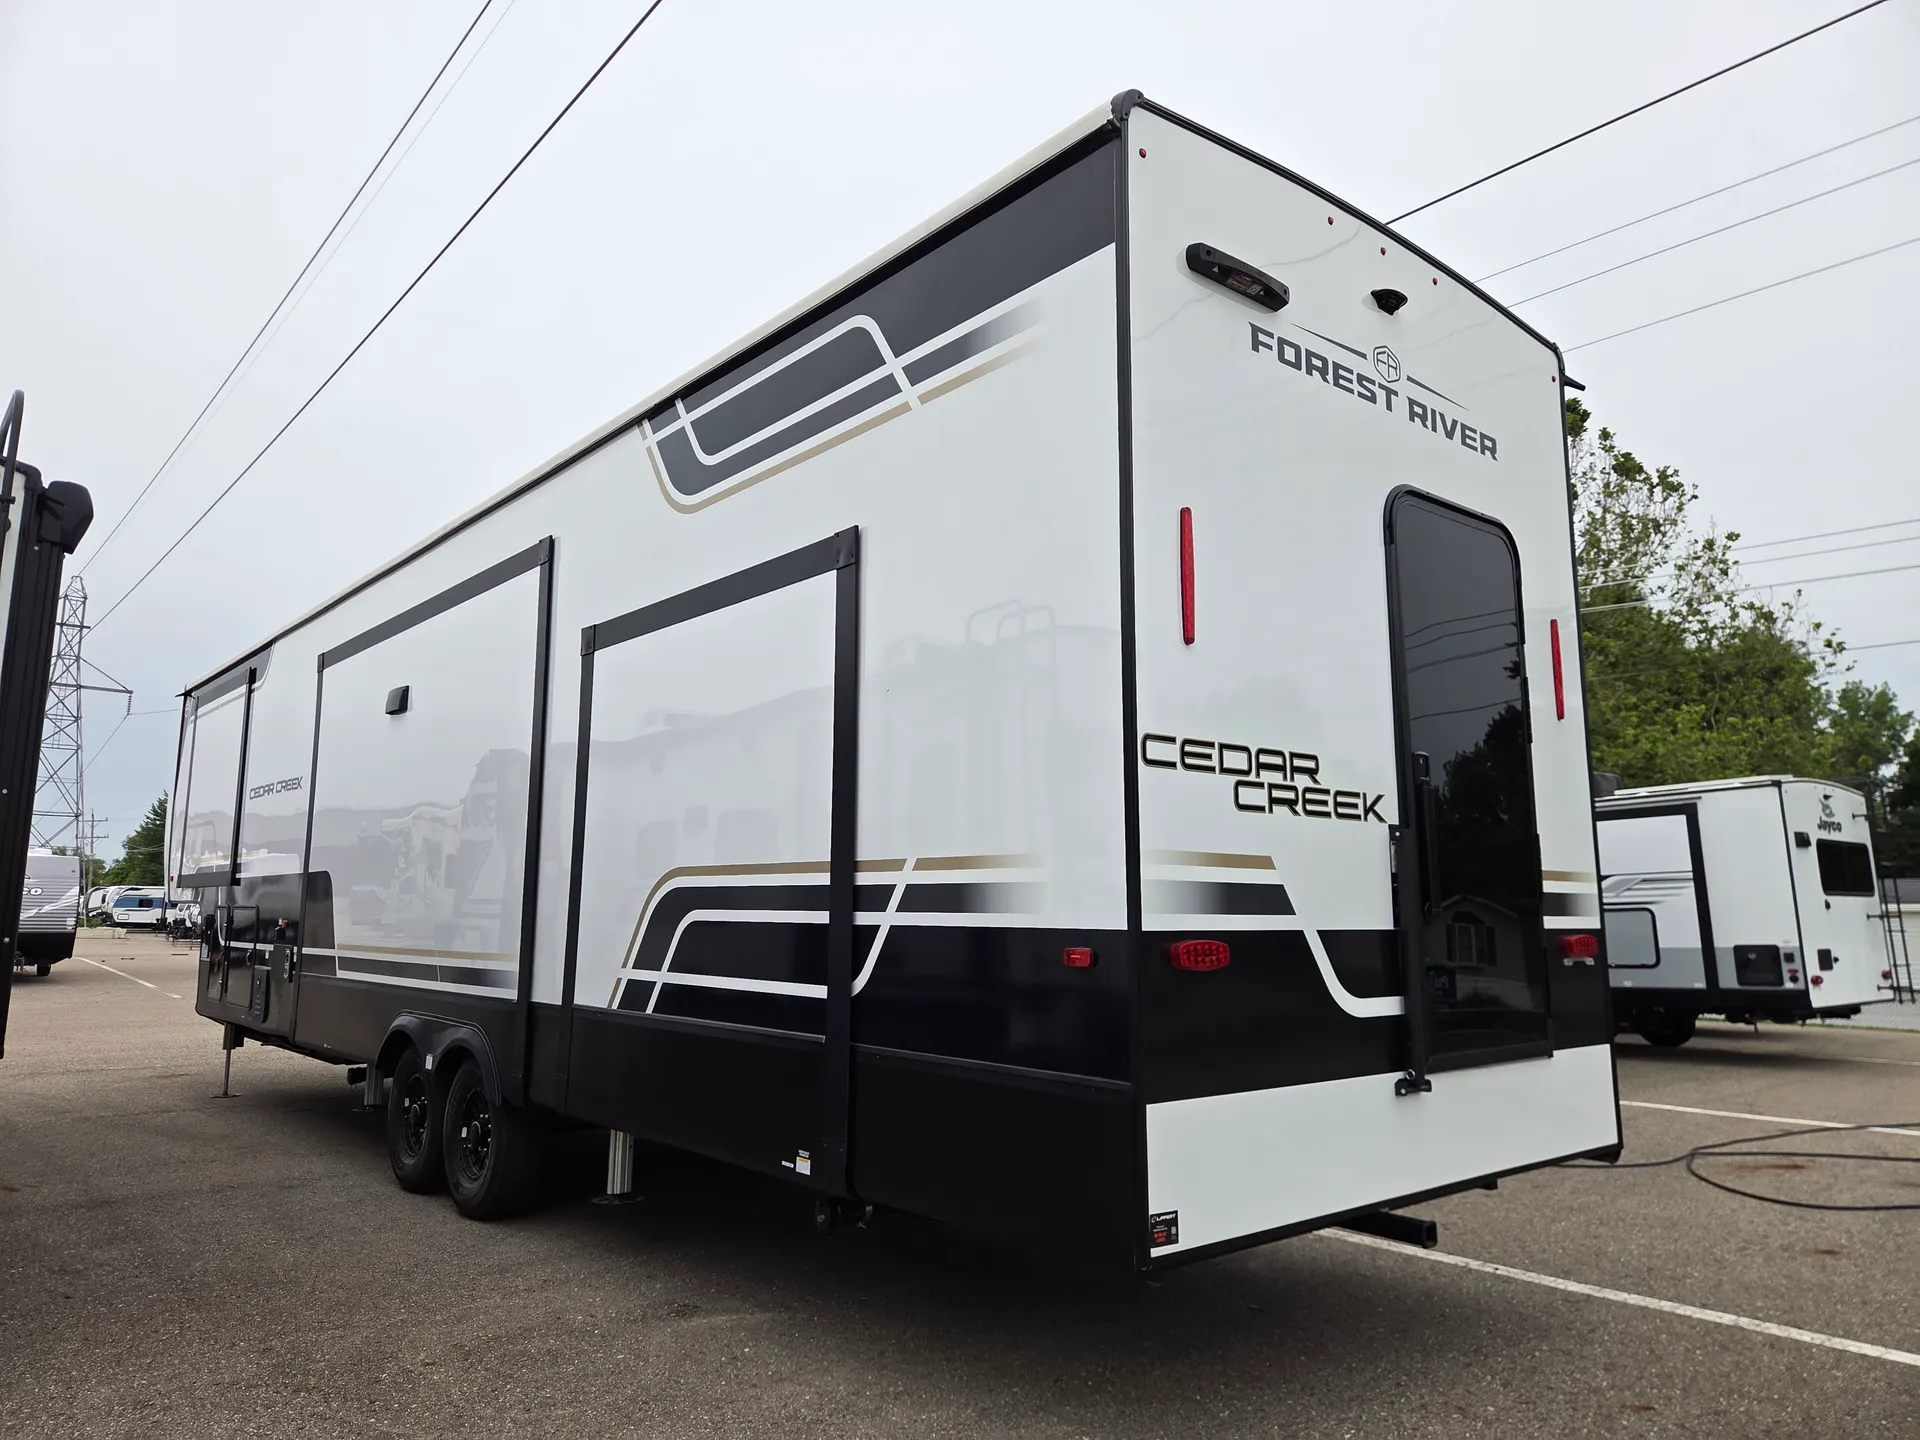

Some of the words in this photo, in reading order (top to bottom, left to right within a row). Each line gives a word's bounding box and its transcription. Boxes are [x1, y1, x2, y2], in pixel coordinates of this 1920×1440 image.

[1250, 322, 1398, 412] FOREST
[1407, 397, 1498, 461] RIVER
[1141, 732, 1321, 785] CEDAR
[249, 782, 275, 800] CEDAR
[276, 776, 303, 794] CREEK
[1234, 779, 1387, 823] CREEK
[1818, 816, 1842, 834] Jayco
